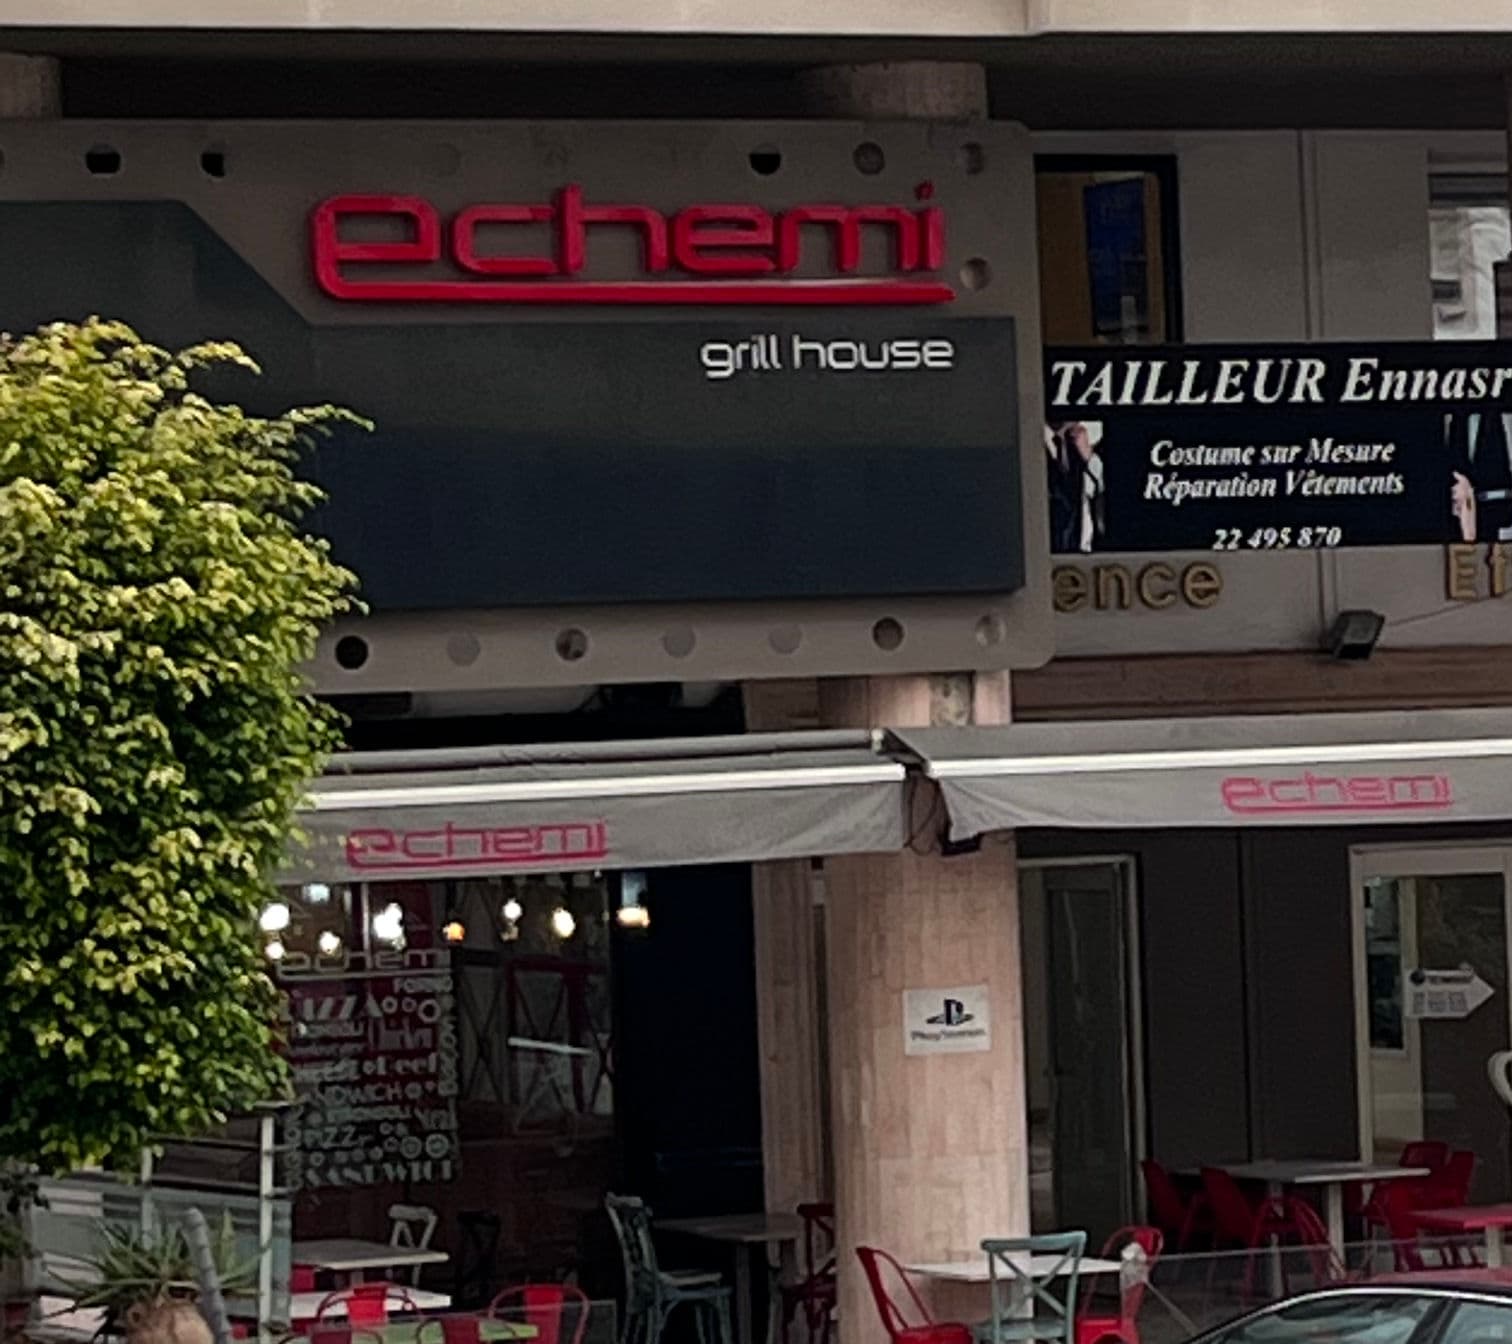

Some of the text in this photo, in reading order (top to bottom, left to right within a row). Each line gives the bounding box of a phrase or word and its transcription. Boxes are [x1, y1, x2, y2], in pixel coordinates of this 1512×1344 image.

[310, 182, 957, 304] echemi
[701, 334, 955, 379] grill house
[1051, 358, 1326, 406] TAILLEUR
[1150, 437, 1396, 468] Costume sur Mesure
[1143, 468, 1405, 506] Réparation Vêtements
[1212, 526, 1343, 550] 22 495 870
[1221, 770, 1456, 816] echemi
